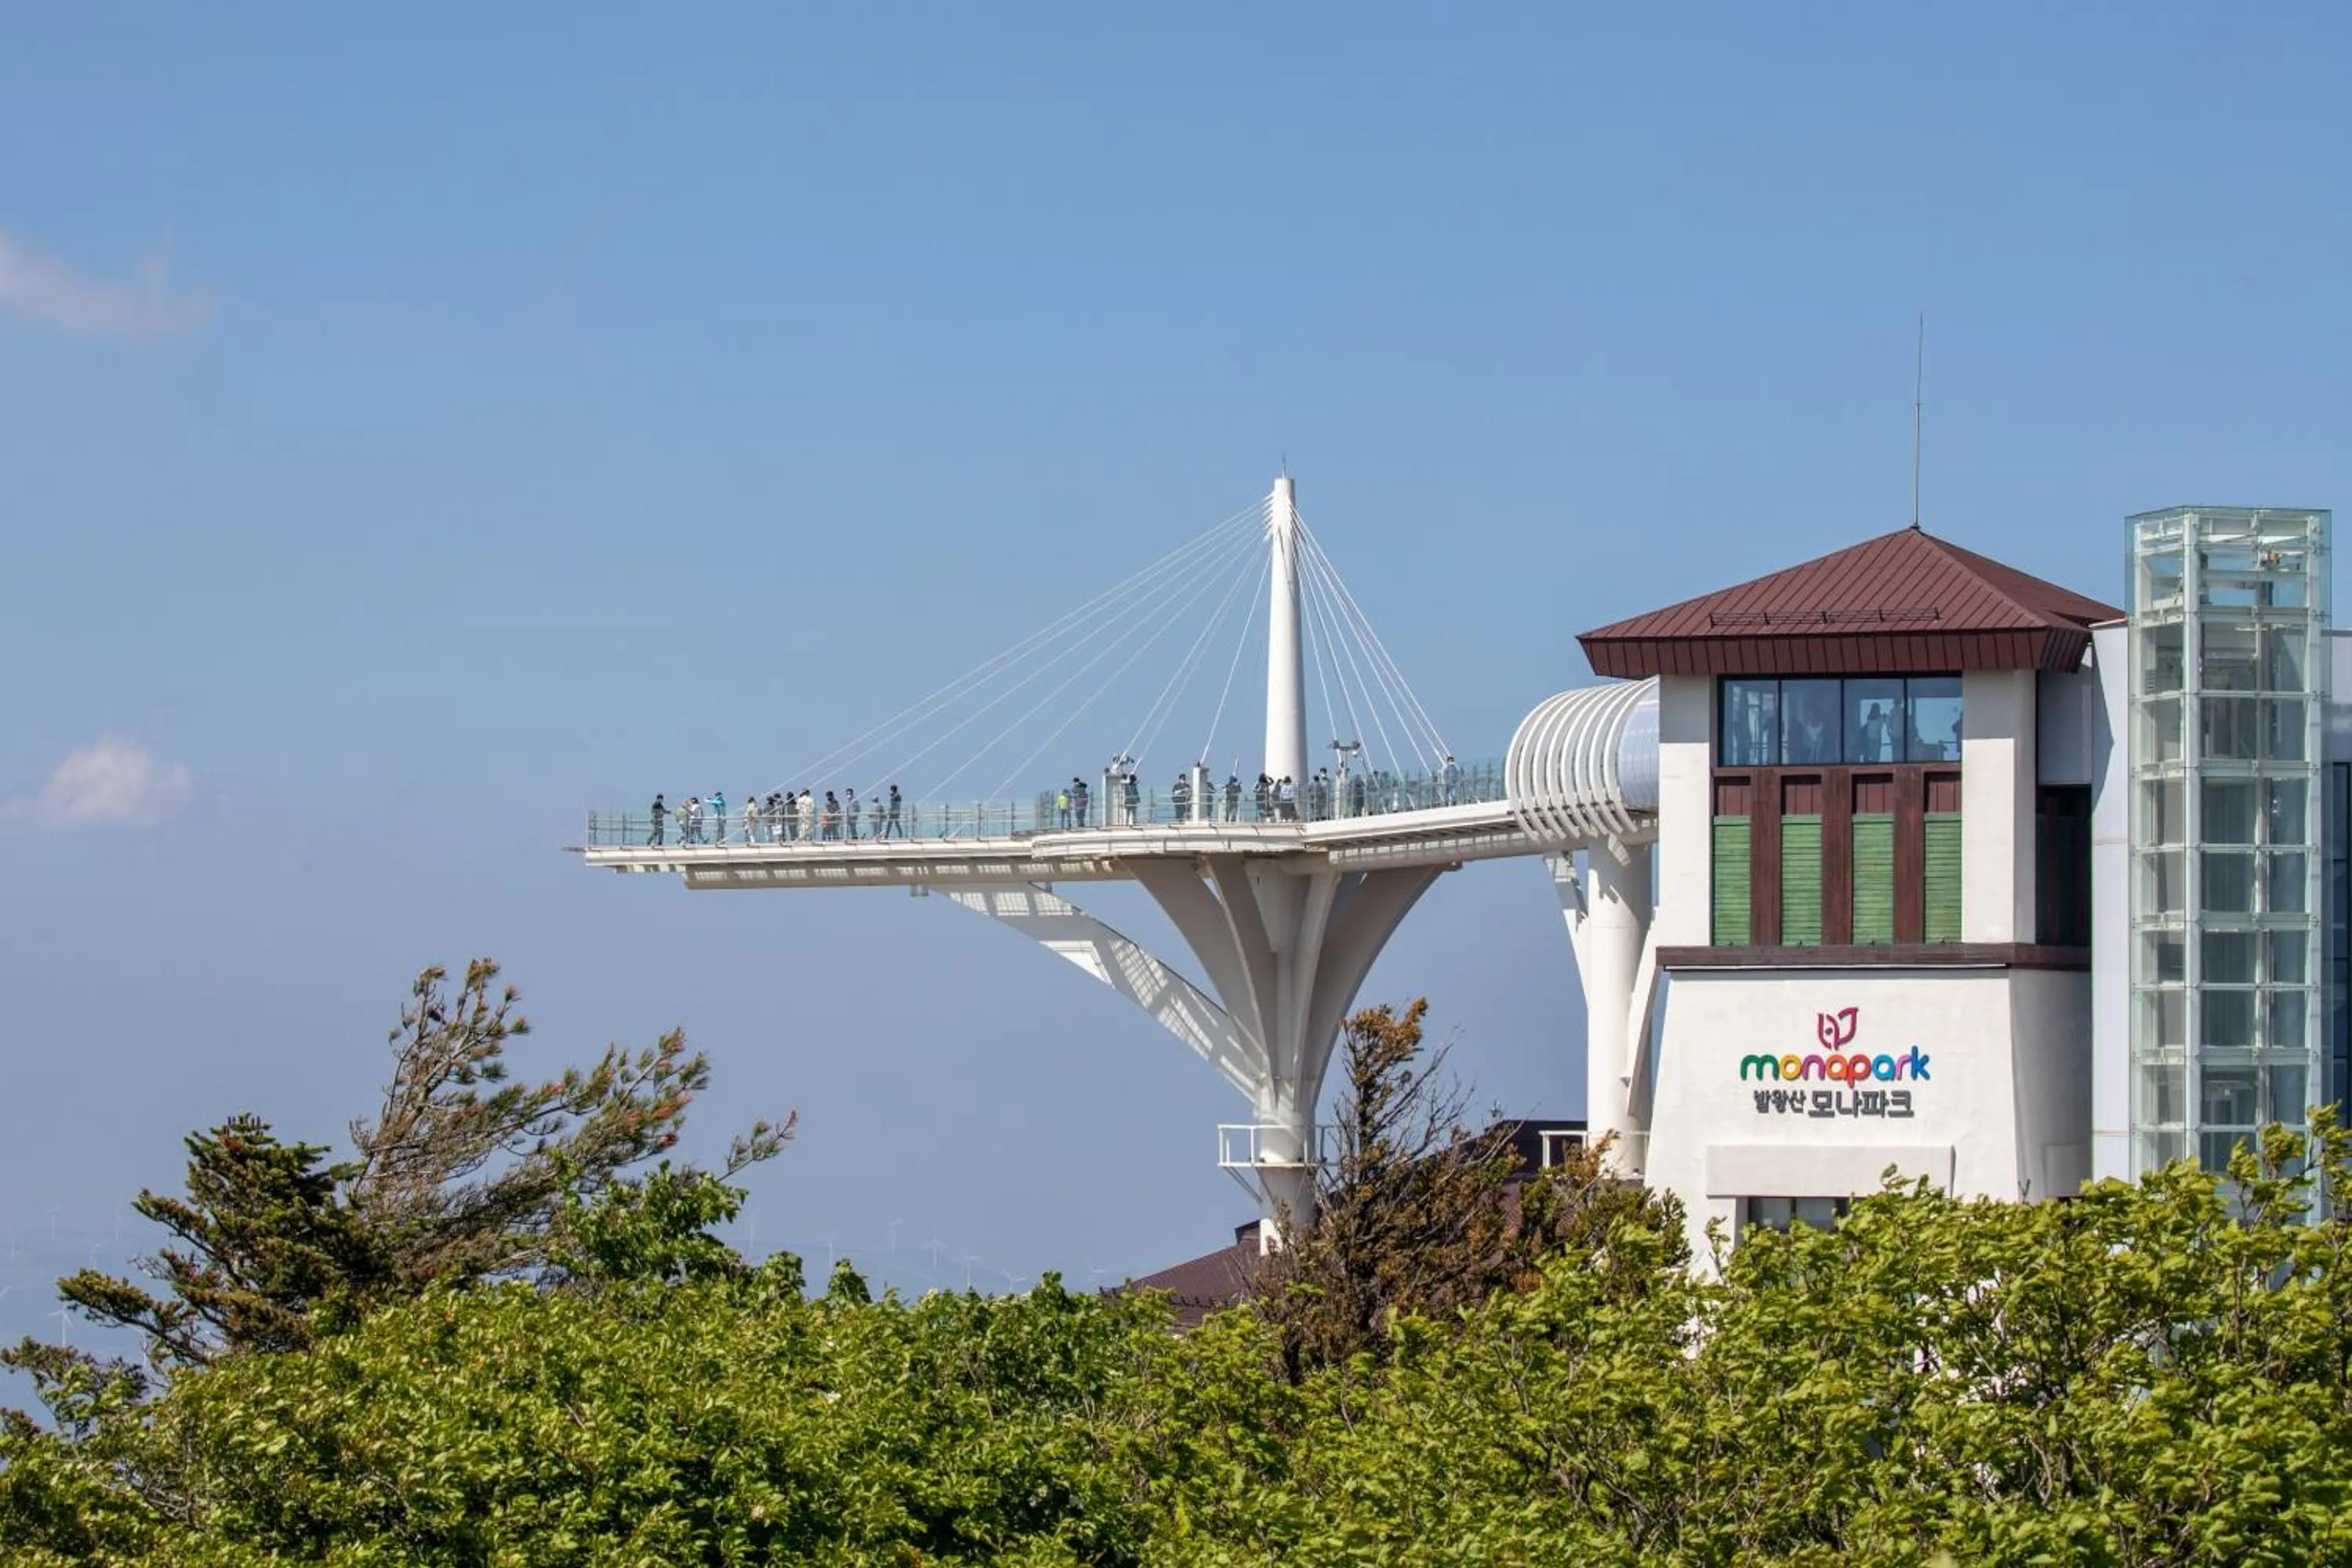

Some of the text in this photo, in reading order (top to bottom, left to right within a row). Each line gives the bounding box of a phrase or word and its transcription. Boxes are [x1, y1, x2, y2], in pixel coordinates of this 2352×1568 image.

[1740, 1045, 1930, 1089] monapark
[1753, 1089, 1915, 1118] 발왕산 모나파크
